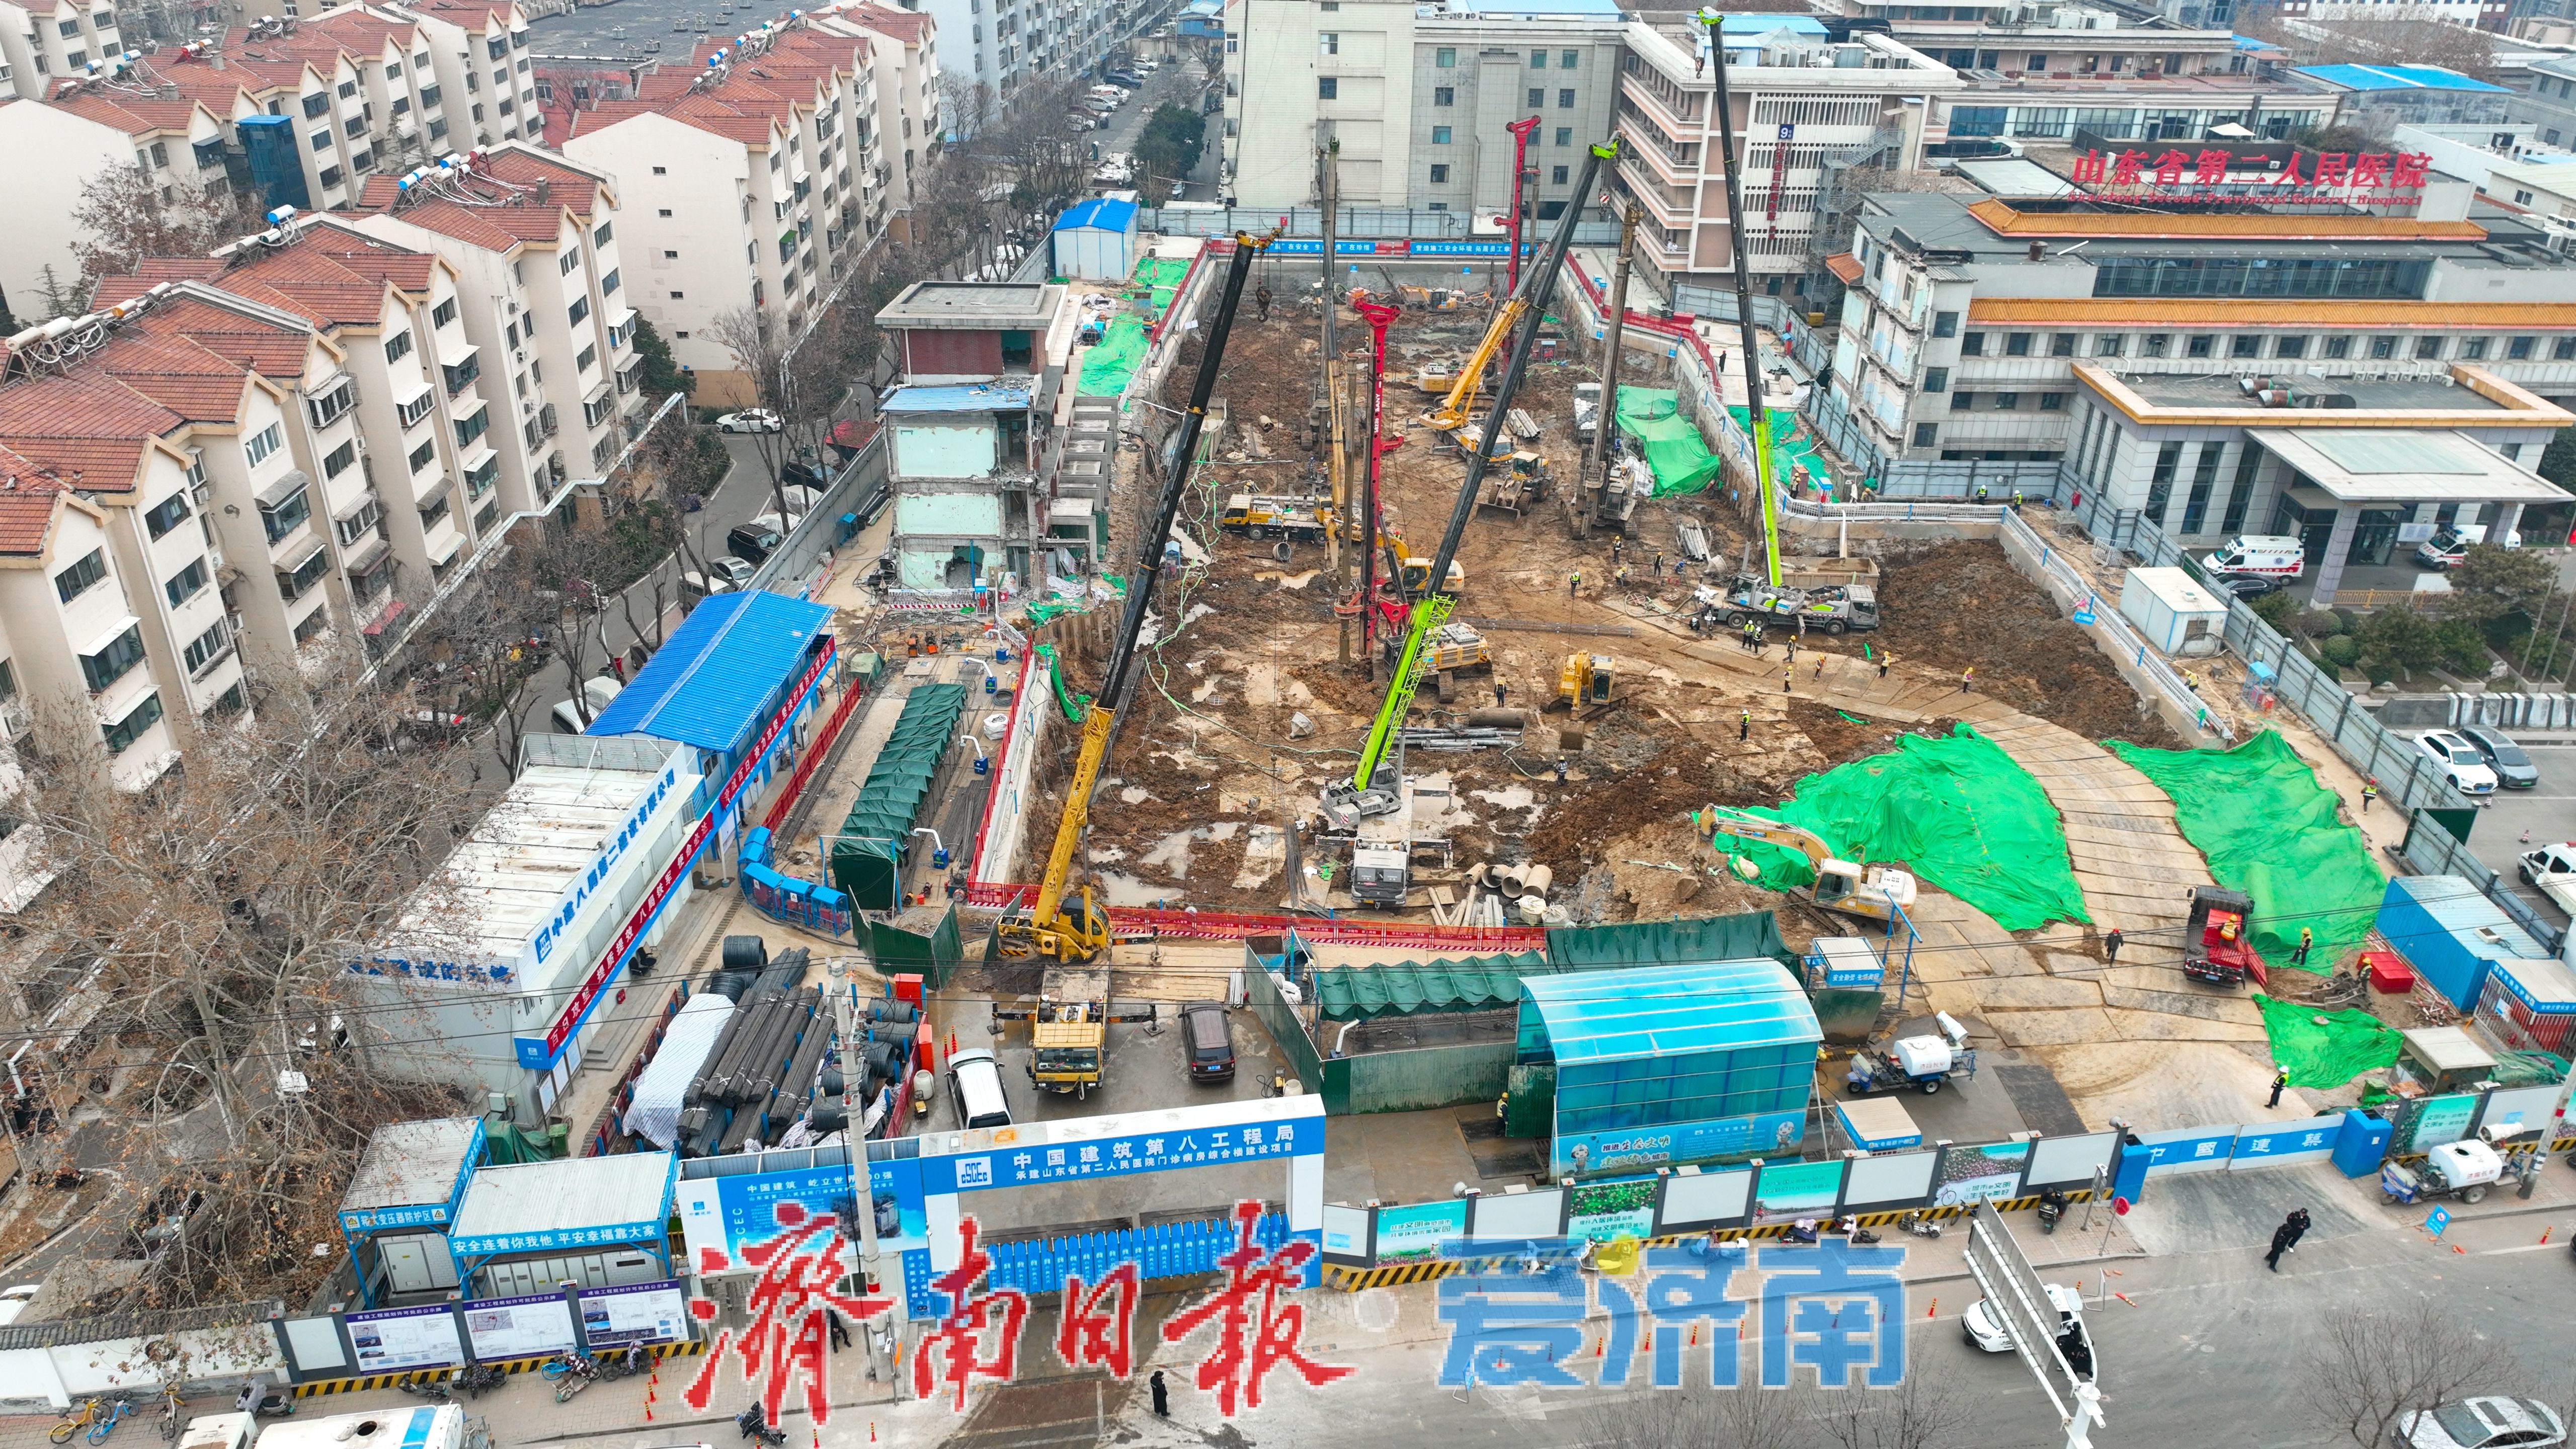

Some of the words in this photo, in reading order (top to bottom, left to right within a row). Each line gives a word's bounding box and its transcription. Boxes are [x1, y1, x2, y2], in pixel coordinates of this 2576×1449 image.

[2072, 148, 2433, 188] 山东省第二人民医院
[2068, 190, 2142, 204] Shandong
[2147, 192, 2200, 204] Second
[2209, 192, 2287, 205] Provincial
[2291, 193, 2350, 205] General
[552, 768, 675, 937] 中建八局第二建设有限公司
[550, 987, 591, 1049] 百日攻坚
[596, 926, 634, 984] 提质提效
[639, 870, 673, 923] 八局铁军
[677, 822, 708, 869] 使命必达
[1013, 1124, 1295, 1169] 中国建筑第八工程局
[1602, 1135, 1670, 1152] 推进生态文明
[1015, 1142, 1293, 1181] 承建山东省第二人民医院门诊病房综合楼建设项目
[1600, 1152, 1669, 1168] 建设绿色城市
[747, 1180, 797, 1193] 中国建筑
[453, 1234, 553, 1253] 安全连着你我他
[558, 1225, 656, 1245] 平安幸福靠大家
[588, 1283, 669, 1296] 建设工程规划许可批后公示牌
[473, 1295, 556, 1308] 建设工程规划许可批后公示牌
[357, 1307, 442, 1320] 建设工程规划许可批后公示牌
